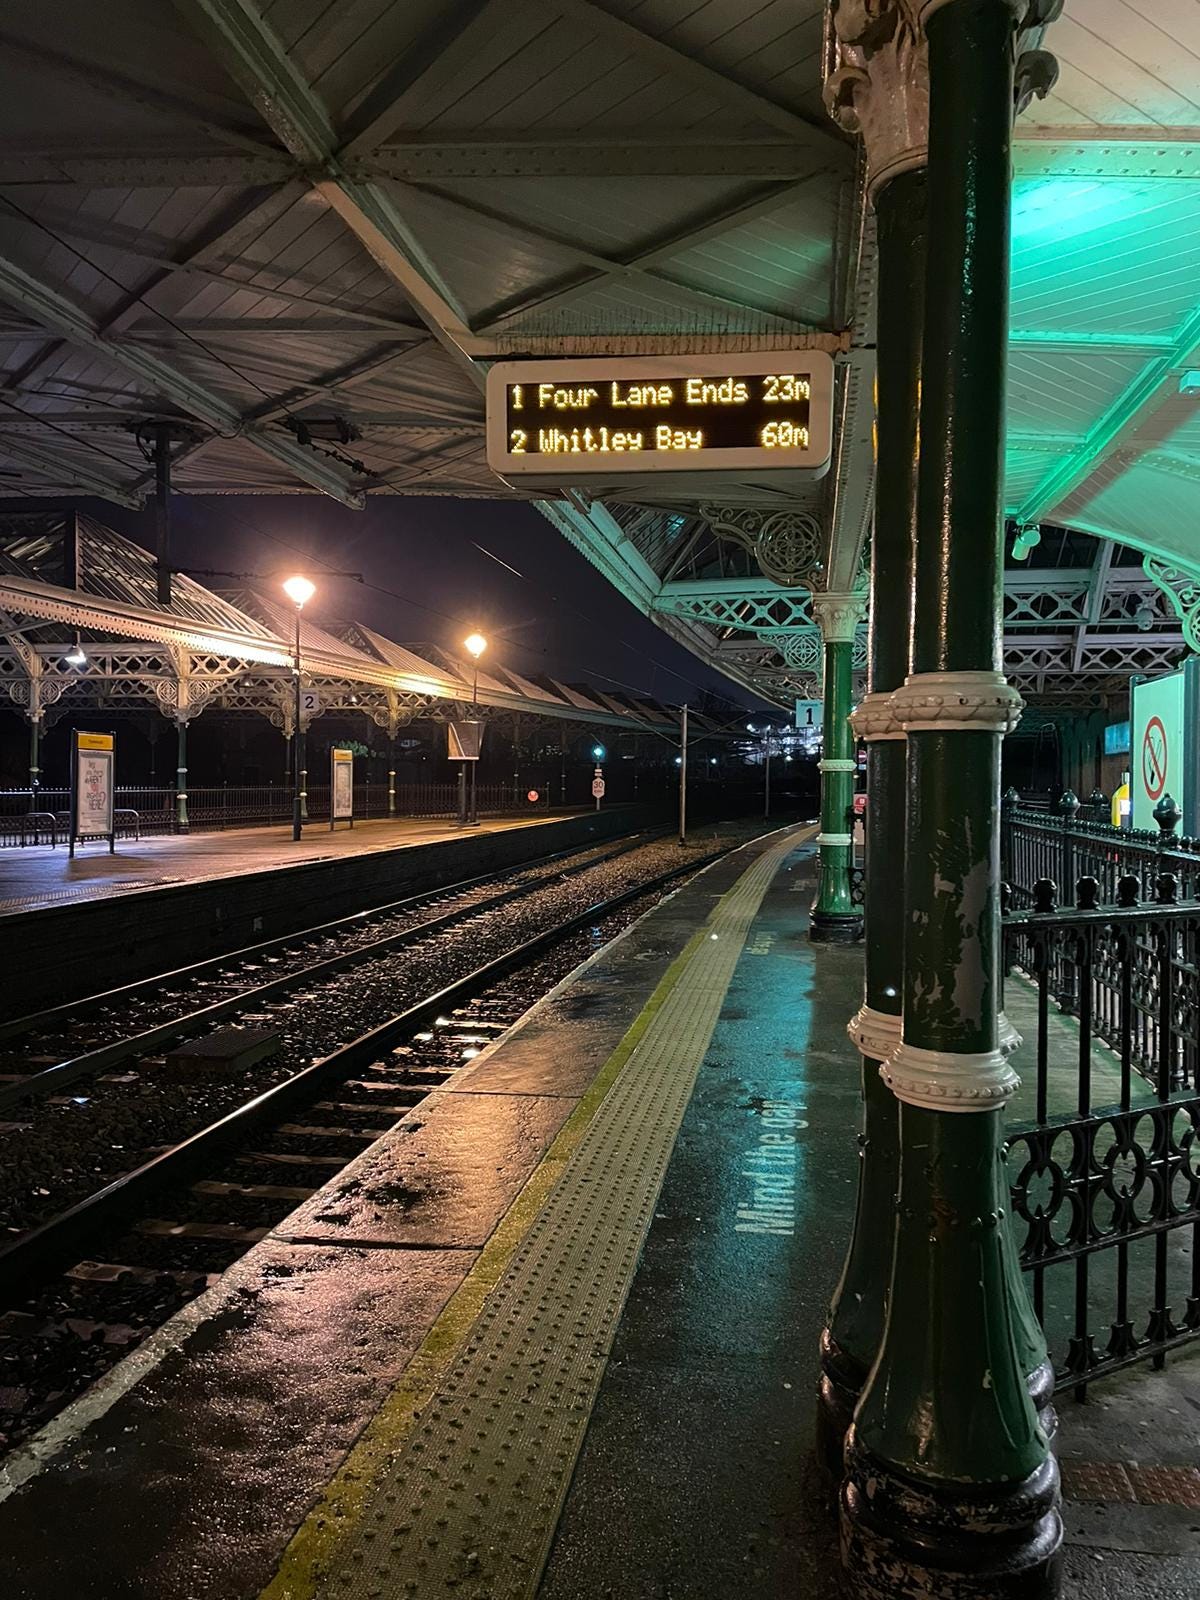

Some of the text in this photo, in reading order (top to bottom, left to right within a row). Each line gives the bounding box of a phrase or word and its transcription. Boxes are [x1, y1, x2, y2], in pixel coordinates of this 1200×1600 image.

[511, 374, 810, 409] 1 Four Lane Ends 23m
[510, 421, 809, 453] 2 Whitley Bay 60m
[305, 696, 314, 709] 2
[806, 707, 814, 725] 1
[734, 1100, 809, 1235] Mind the gap
